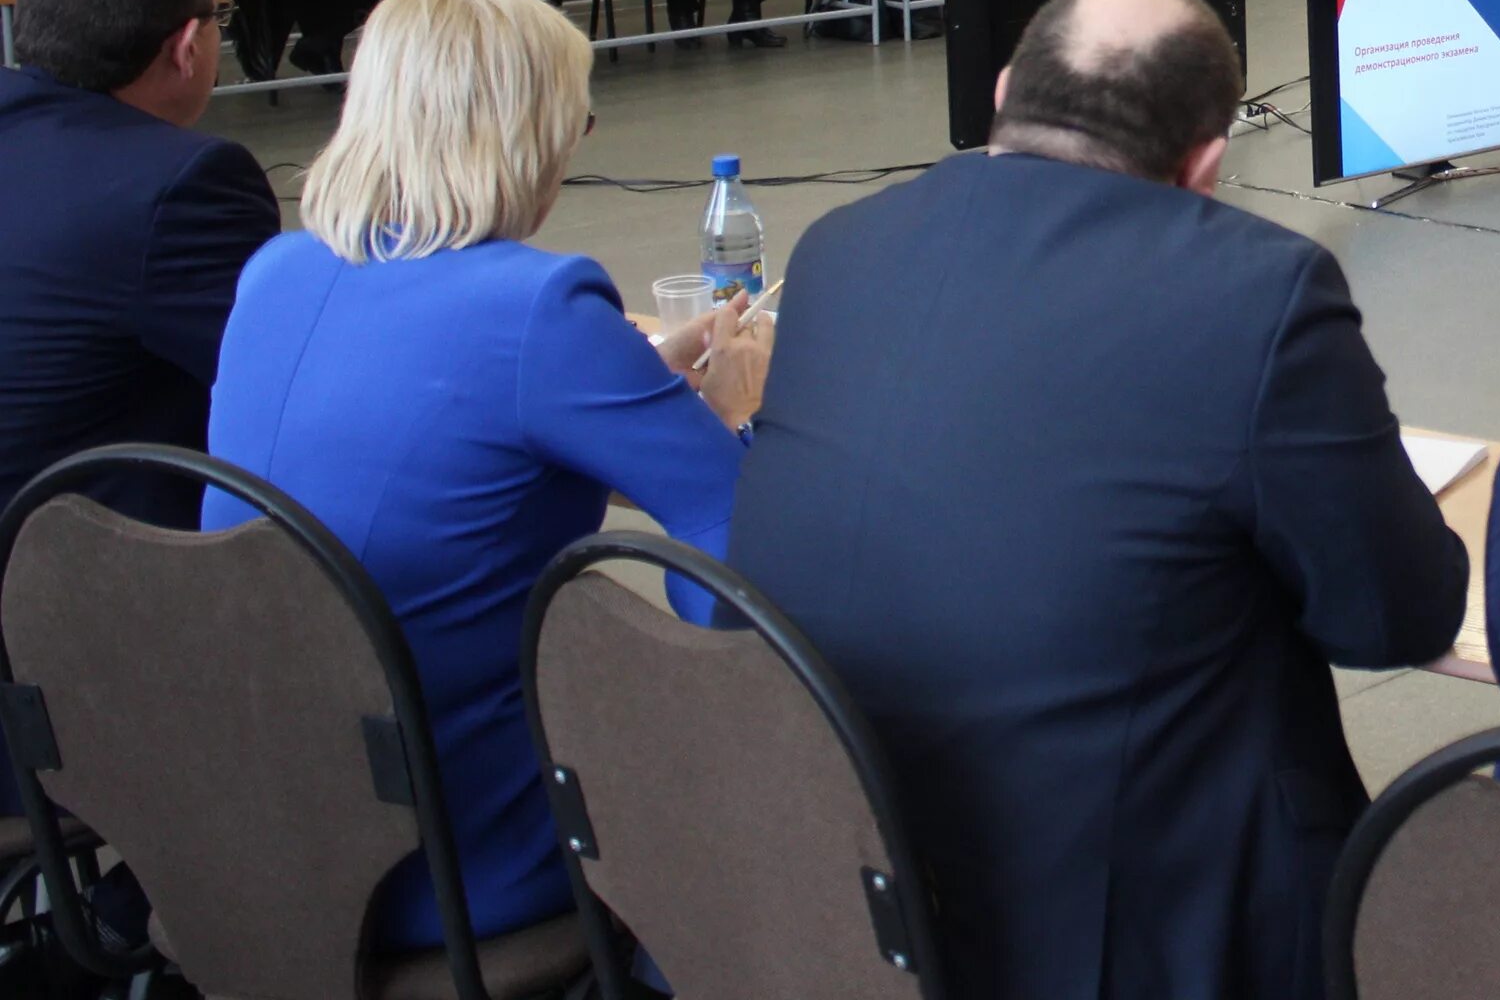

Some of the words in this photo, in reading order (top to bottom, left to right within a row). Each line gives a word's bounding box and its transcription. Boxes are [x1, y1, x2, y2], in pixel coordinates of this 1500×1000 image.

[1354, 41, 1409, 58] Организация
[1411, 32, 1460, 48] проведения
[1354, 52, 1439, 74] демонстрационного
[1441, 45, 1479, 59] экзамена
